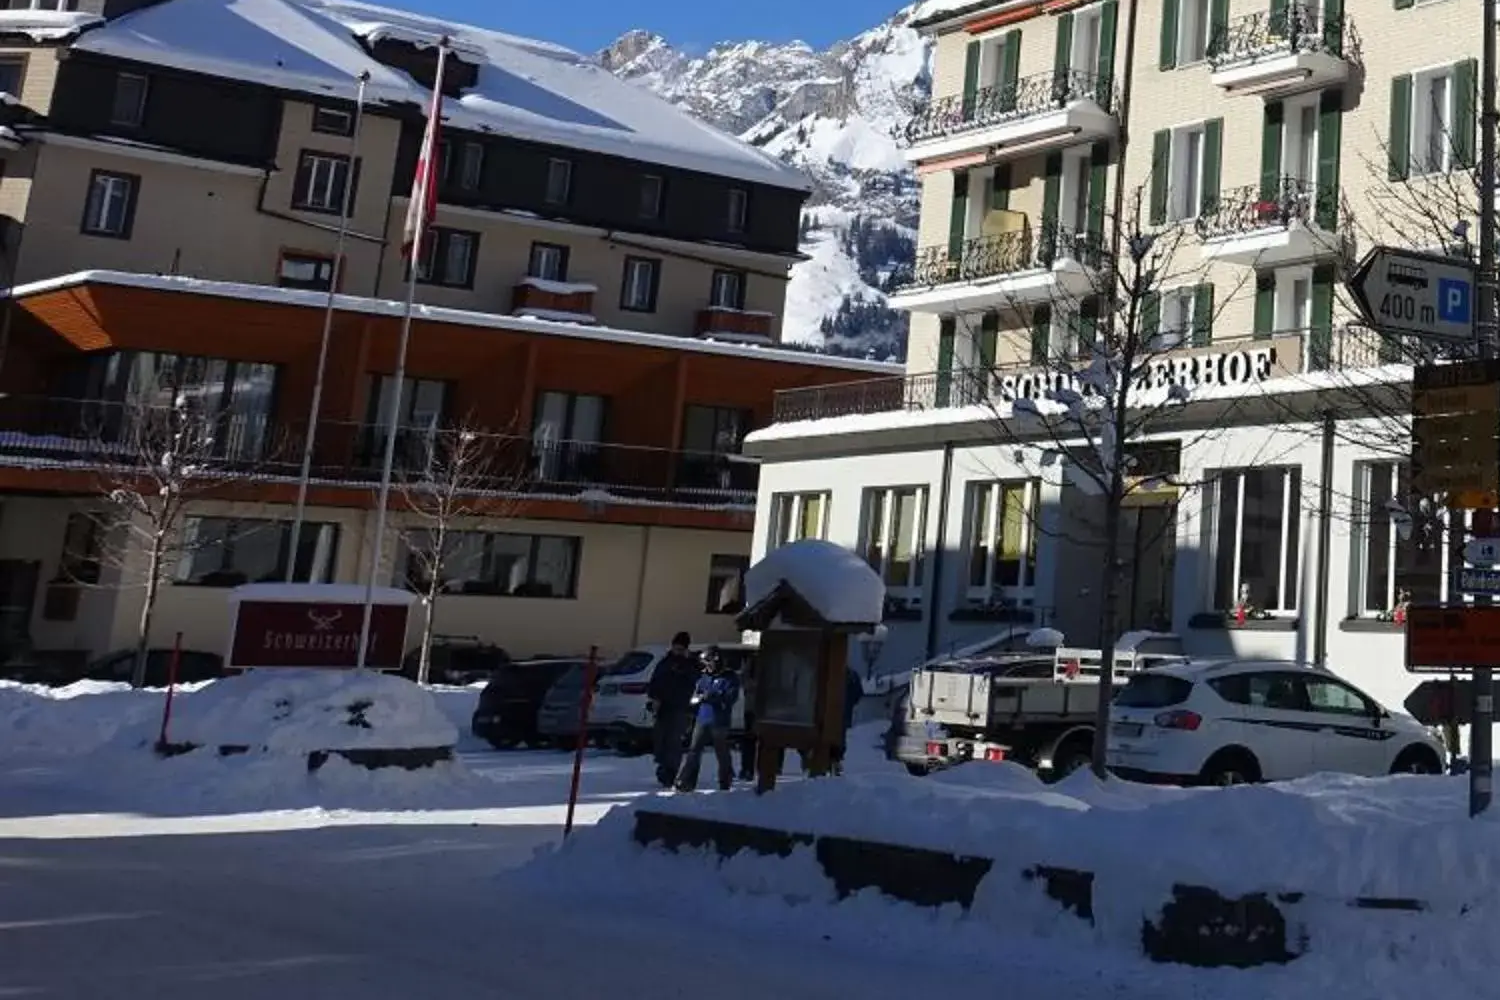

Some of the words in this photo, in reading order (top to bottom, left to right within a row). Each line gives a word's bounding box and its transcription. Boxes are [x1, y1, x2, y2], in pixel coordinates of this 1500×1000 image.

[1380, 293, 1415, 321] 400
[1420, 304, 1436, 326] m
[1446, 288, 1462, 313] P
[1001, 347, 1277, 402] SCHWZERHOF
[263, 628, 378, 653] Schweizerhf
